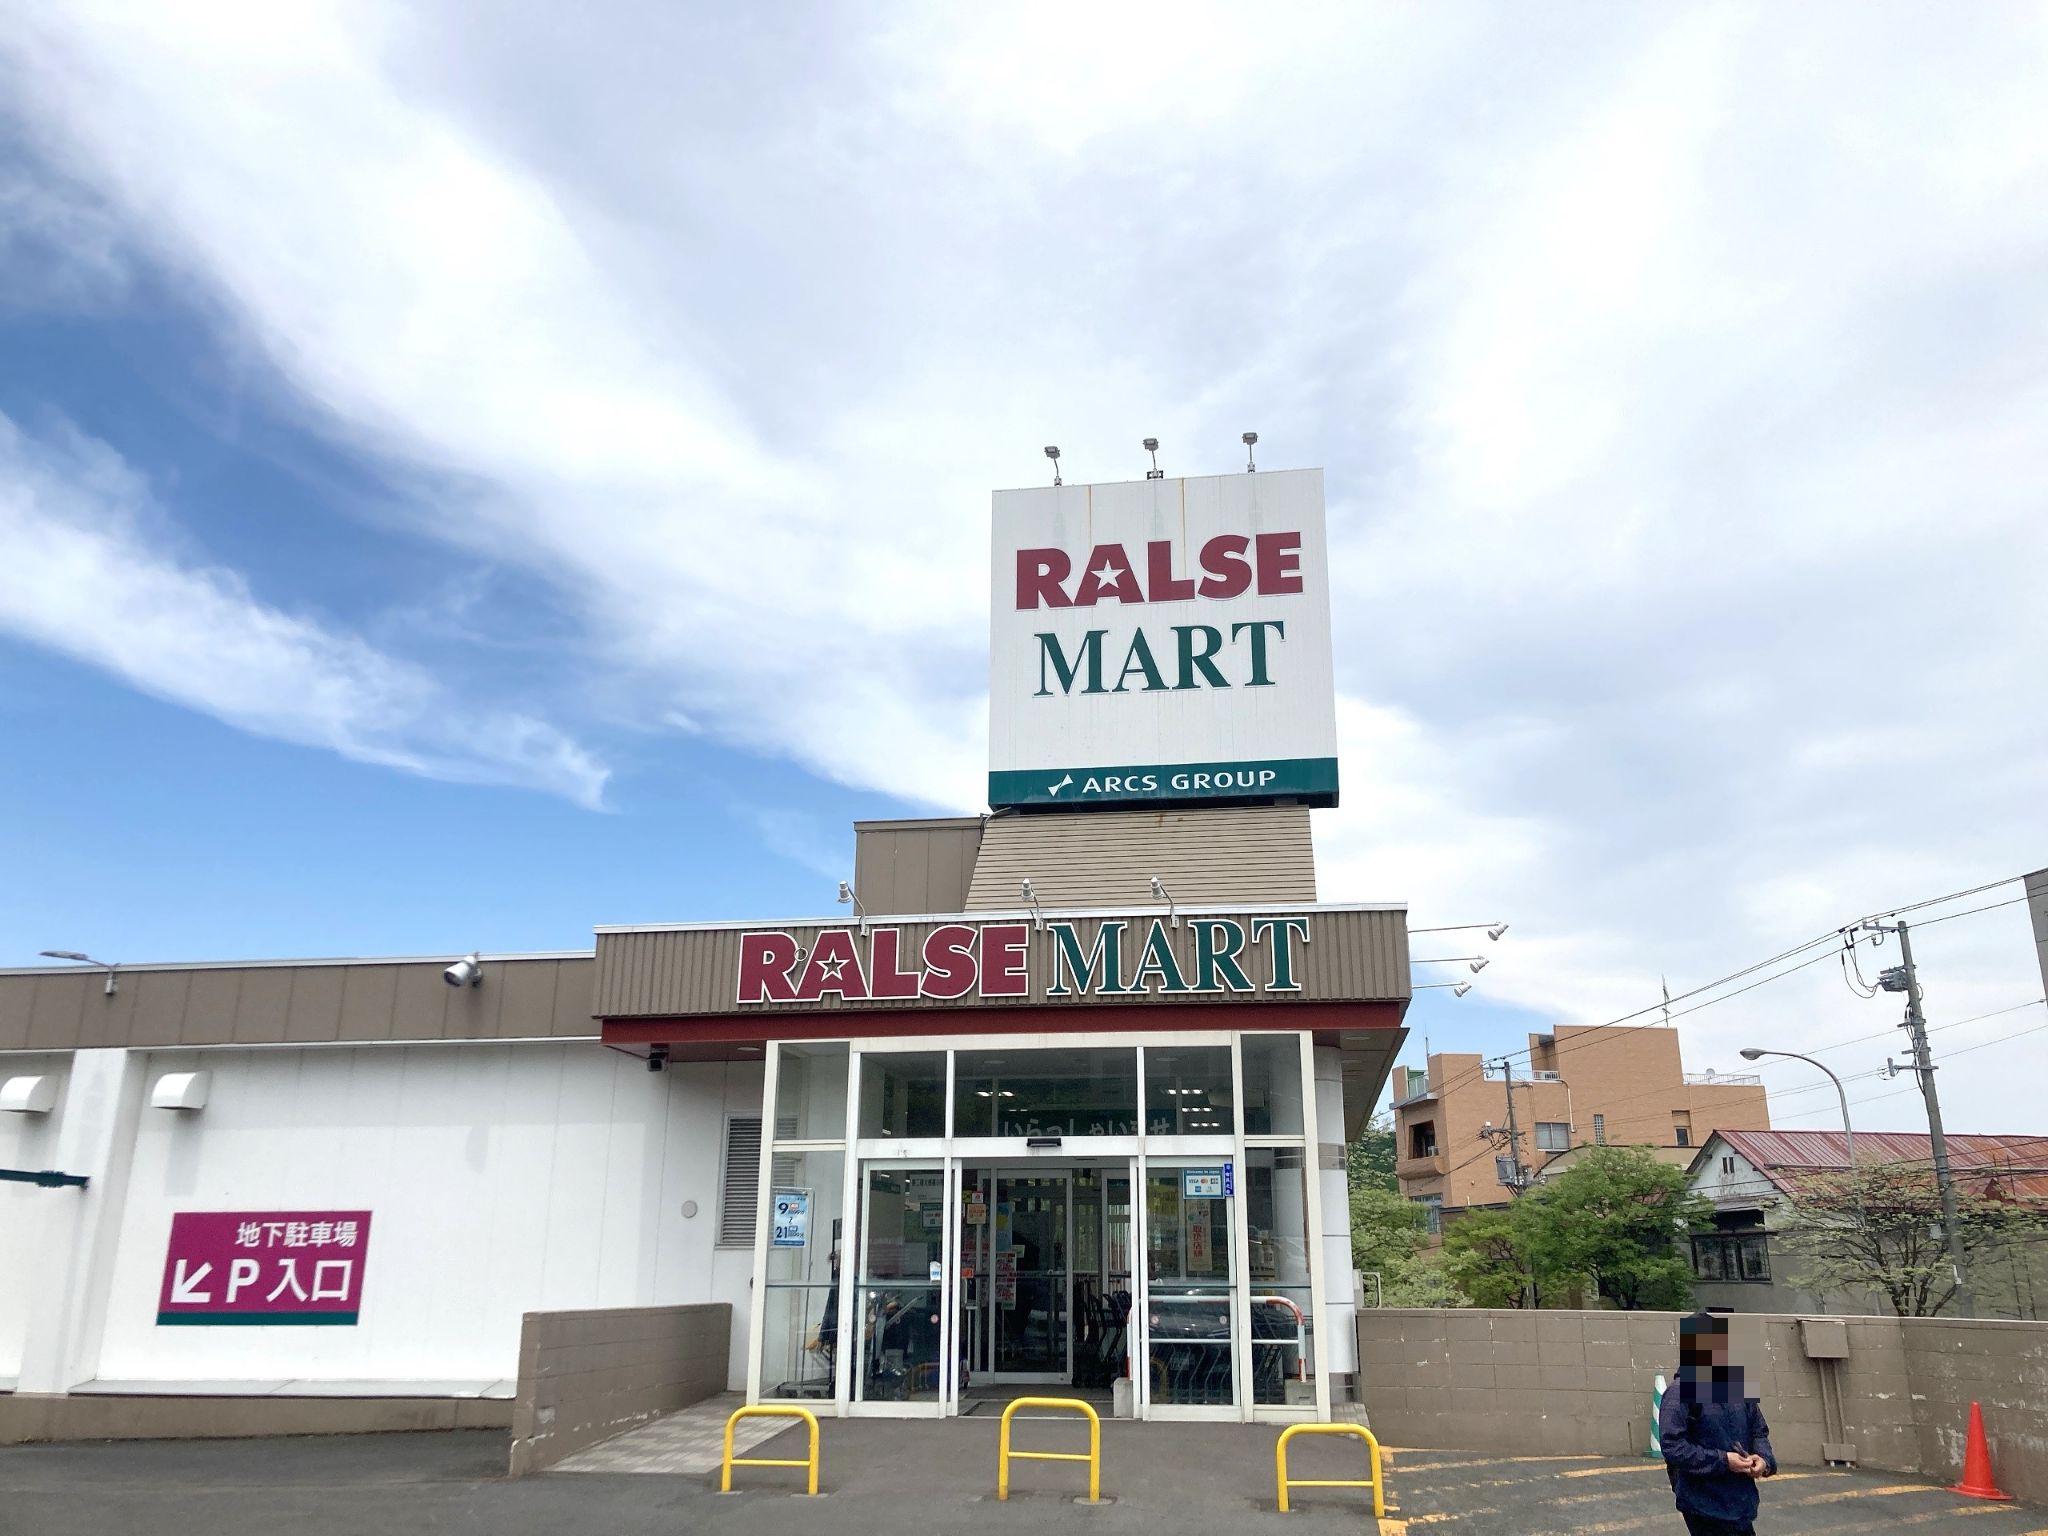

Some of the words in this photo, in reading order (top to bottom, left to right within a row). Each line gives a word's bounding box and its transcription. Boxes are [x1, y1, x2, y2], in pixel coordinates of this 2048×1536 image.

[1015, 531, 1304, 611] RALSE
[1032, 620, 1286, 698] MART
[1081, 774, 1158, 794] ARCS
[1171, 769, 1277, 790] GROUP
[736, 923, 1030, 1005] RALSE
[1046, 916, 1311, 997] MART
[778, 1202, 789, 1215] 9
[234, 1221, 358, 1248] 地下駐車場
[775, 1226, 788, 1239] 21
[225, 1258, 261, 1304] P
[265, 1258, 354, 1303] 入口
